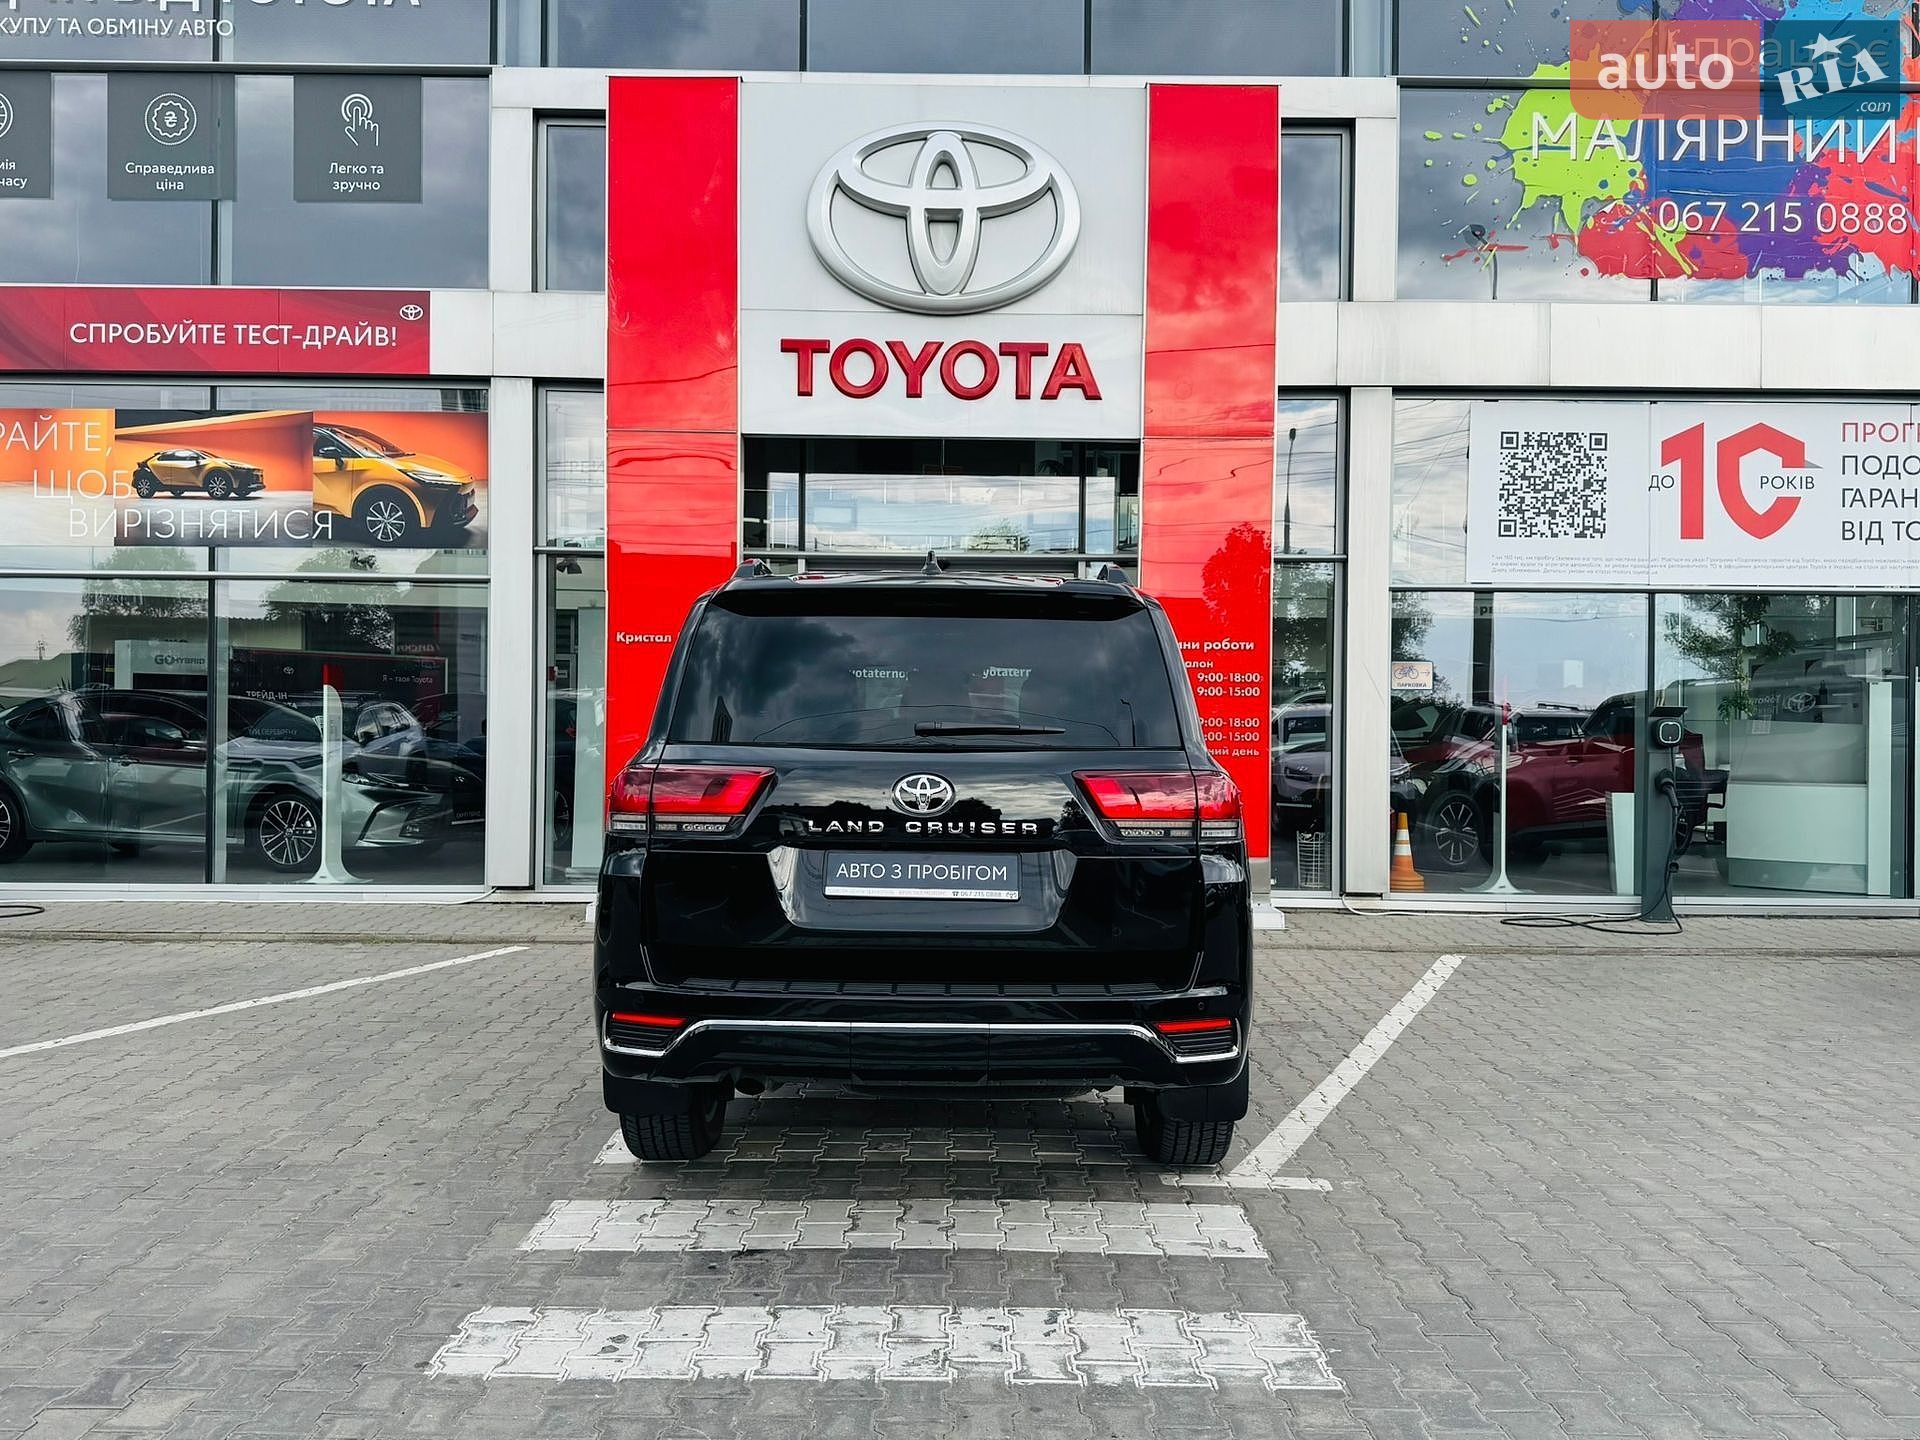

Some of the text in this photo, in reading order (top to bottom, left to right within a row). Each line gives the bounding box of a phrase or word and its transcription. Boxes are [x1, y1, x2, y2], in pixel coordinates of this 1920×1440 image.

[57, 18, 82, 34] ТА
[87, 18, 174, 36] ОБМІНУ
[179, 18, 234, 37] АВТО
[125, 161, 215, 176] Справедлива
[329, 162, 384, 176] Легко та
[156, 178, 185, 191] ціна
[332, 180, 381, 193] зручно
[1658, 200, 1908, 234] 067 215 0888
[69, 320, 398, 348] СПРОБУЙТЕ ТЕСТ-ДРАЙВ!
[780, 338, 1103, 401] TOYOTA
[1842, 422, 1920, 442] ПРОГ
[33, 469, 132, 505] ЩОБ
[1648, 422, 1815, 540] ДО 10 РОКІВ
[1842, 488, 1918, 508] ГАРАН
[69, 509, 333, 541] ВИРІЗНЯТИСЯ
[1842, 521, 1884, 545] ВІД
[616, 631, 672, 645] Кристал
[1203, 638, 1255, 653] роботи
[1197, 672, 1261, 683] 9:00-18:00
[1196, 687, 1261, 697] 9:00-15:00
[1203, 731, 1260, 742] :00-15:00
[1231, 748, 1260, 757] день
[807, 820, 1038, 835] LAND CRUISER
[836, 863, 886, 879] АВТО
[908, 864, 1008, 881] ПРОБІГОМ
